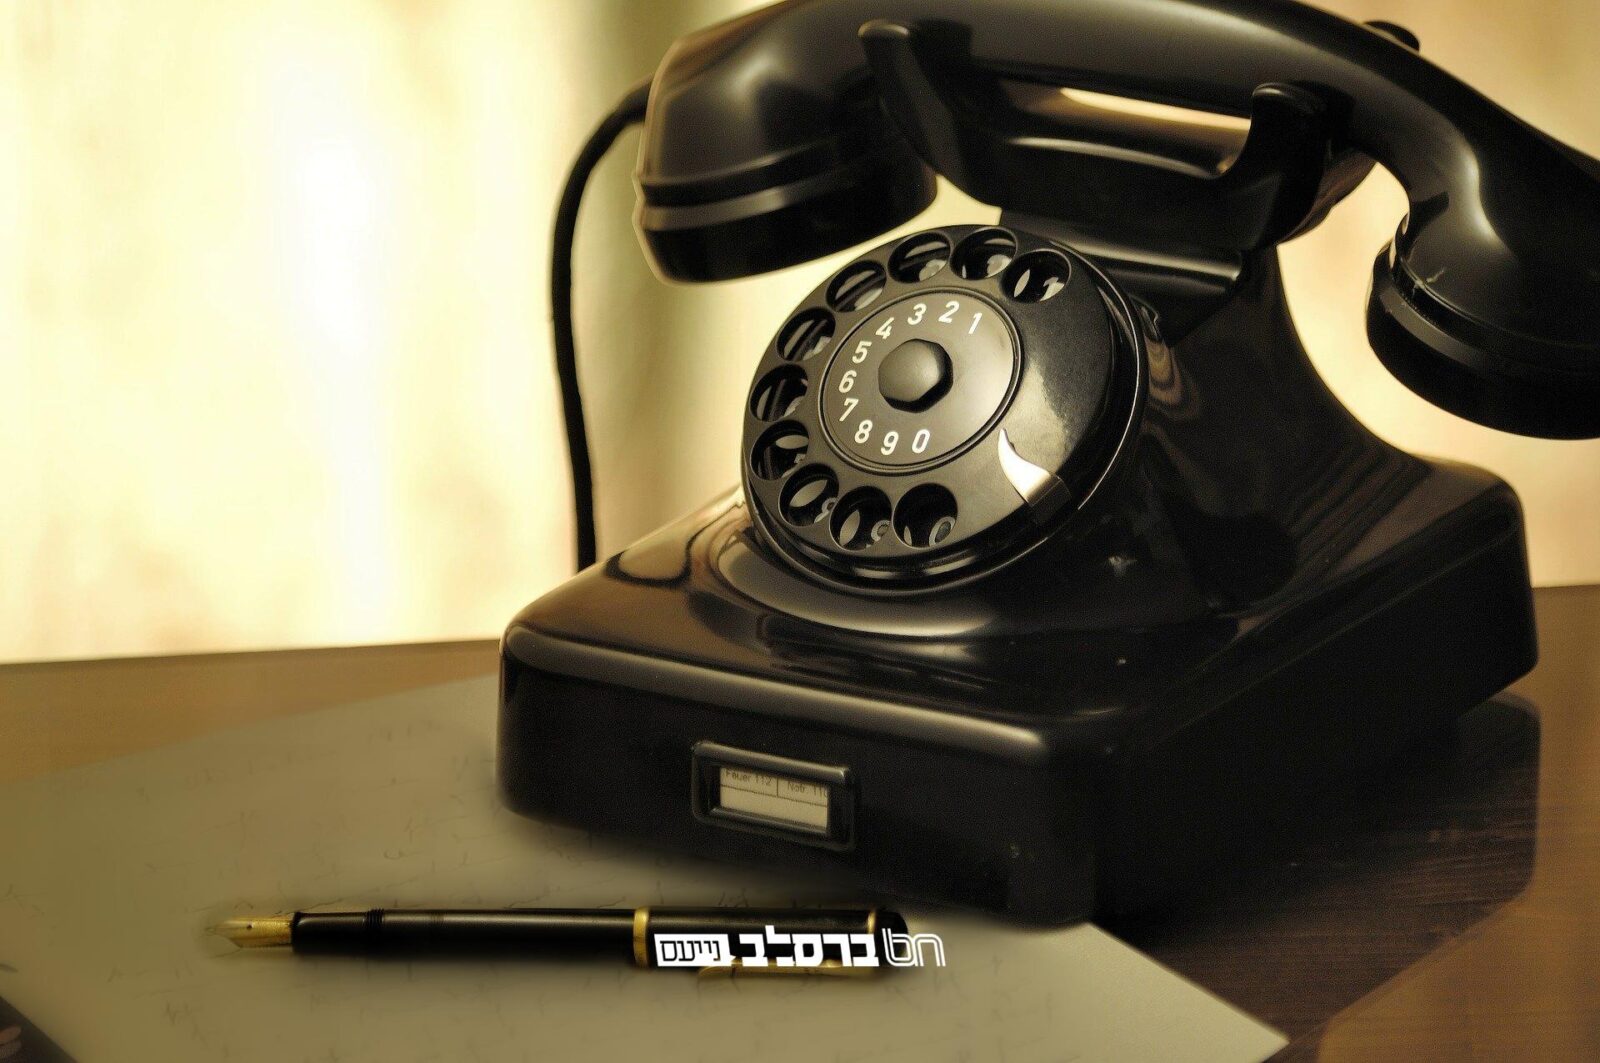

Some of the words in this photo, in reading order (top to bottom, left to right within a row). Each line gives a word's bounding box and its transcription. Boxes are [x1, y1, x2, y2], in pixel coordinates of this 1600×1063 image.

[907, 303, 927, 326] 3
[938, 301, 960, 324] 2
[967, 312, 983, 335] 1
[875, 317, 895, 340] 4
[852, 341, 872, 364] 5
[838, 370, 857, 393] 6
[839, 398, 859, 422] 7
[854, 419, 873, 444] 8
[911, 429, 931, 454] 0
[880, 431, 899, 456] 9
